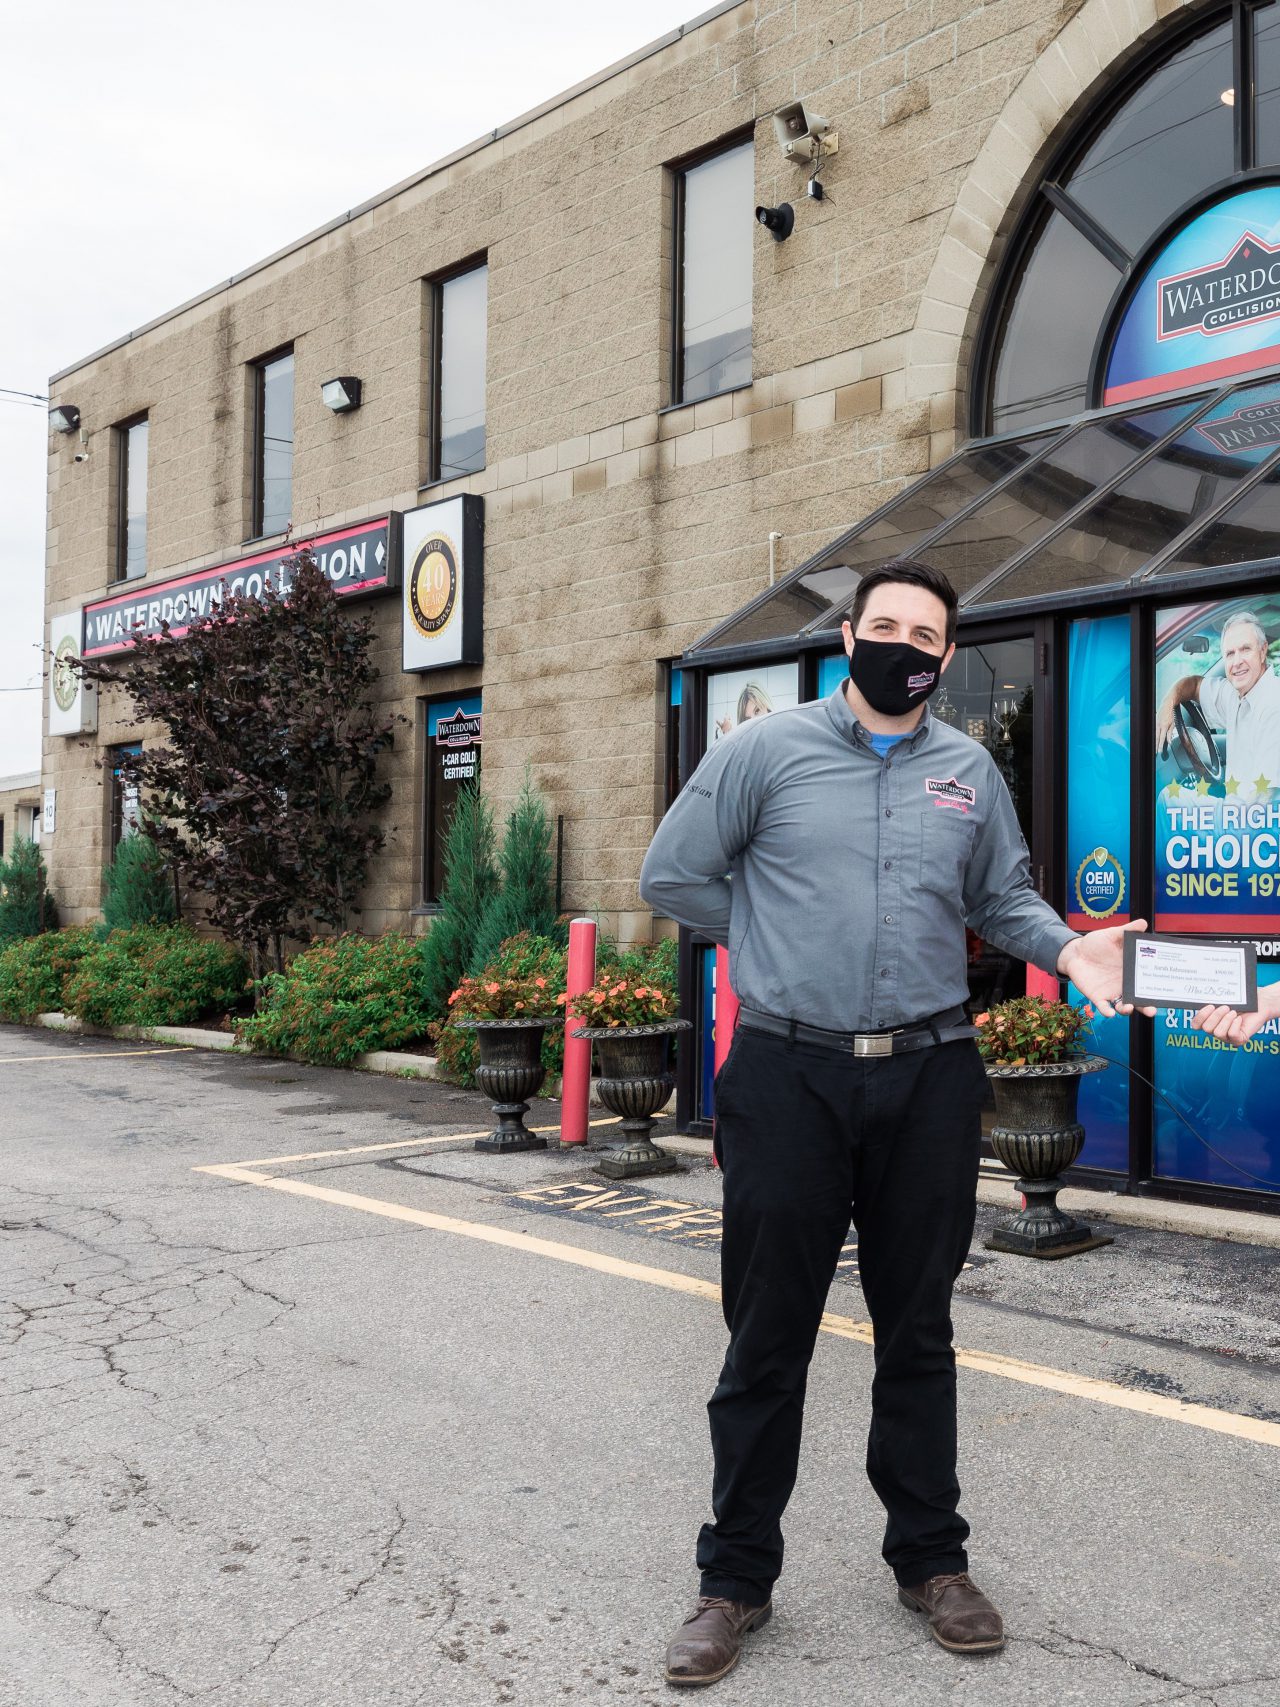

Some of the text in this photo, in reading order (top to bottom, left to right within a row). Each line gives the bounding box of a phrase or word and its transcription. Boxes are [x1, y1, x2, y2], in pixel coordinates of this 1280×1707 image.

[425, 540, 442, 553] OVER
[230, 541, 367, 604] COLLION
[422, 563, 445, 593] 40
[420, 592, 445, 607] YEARS
[439, 719, 480, 736] WATERDOWN
[442, 750, 476, 766] I-CAR GOLD
[444, 765, 474, 780] CERTIFIED
[1166, 806, 1215, 831] THE
[1085, 871, 1115, 885] OEM
[1165, 873, 1239, 897] SINCE
[1085, 885, 1115, 895] CERTIFIED
[1165, 1008, 1178, 1029] &
